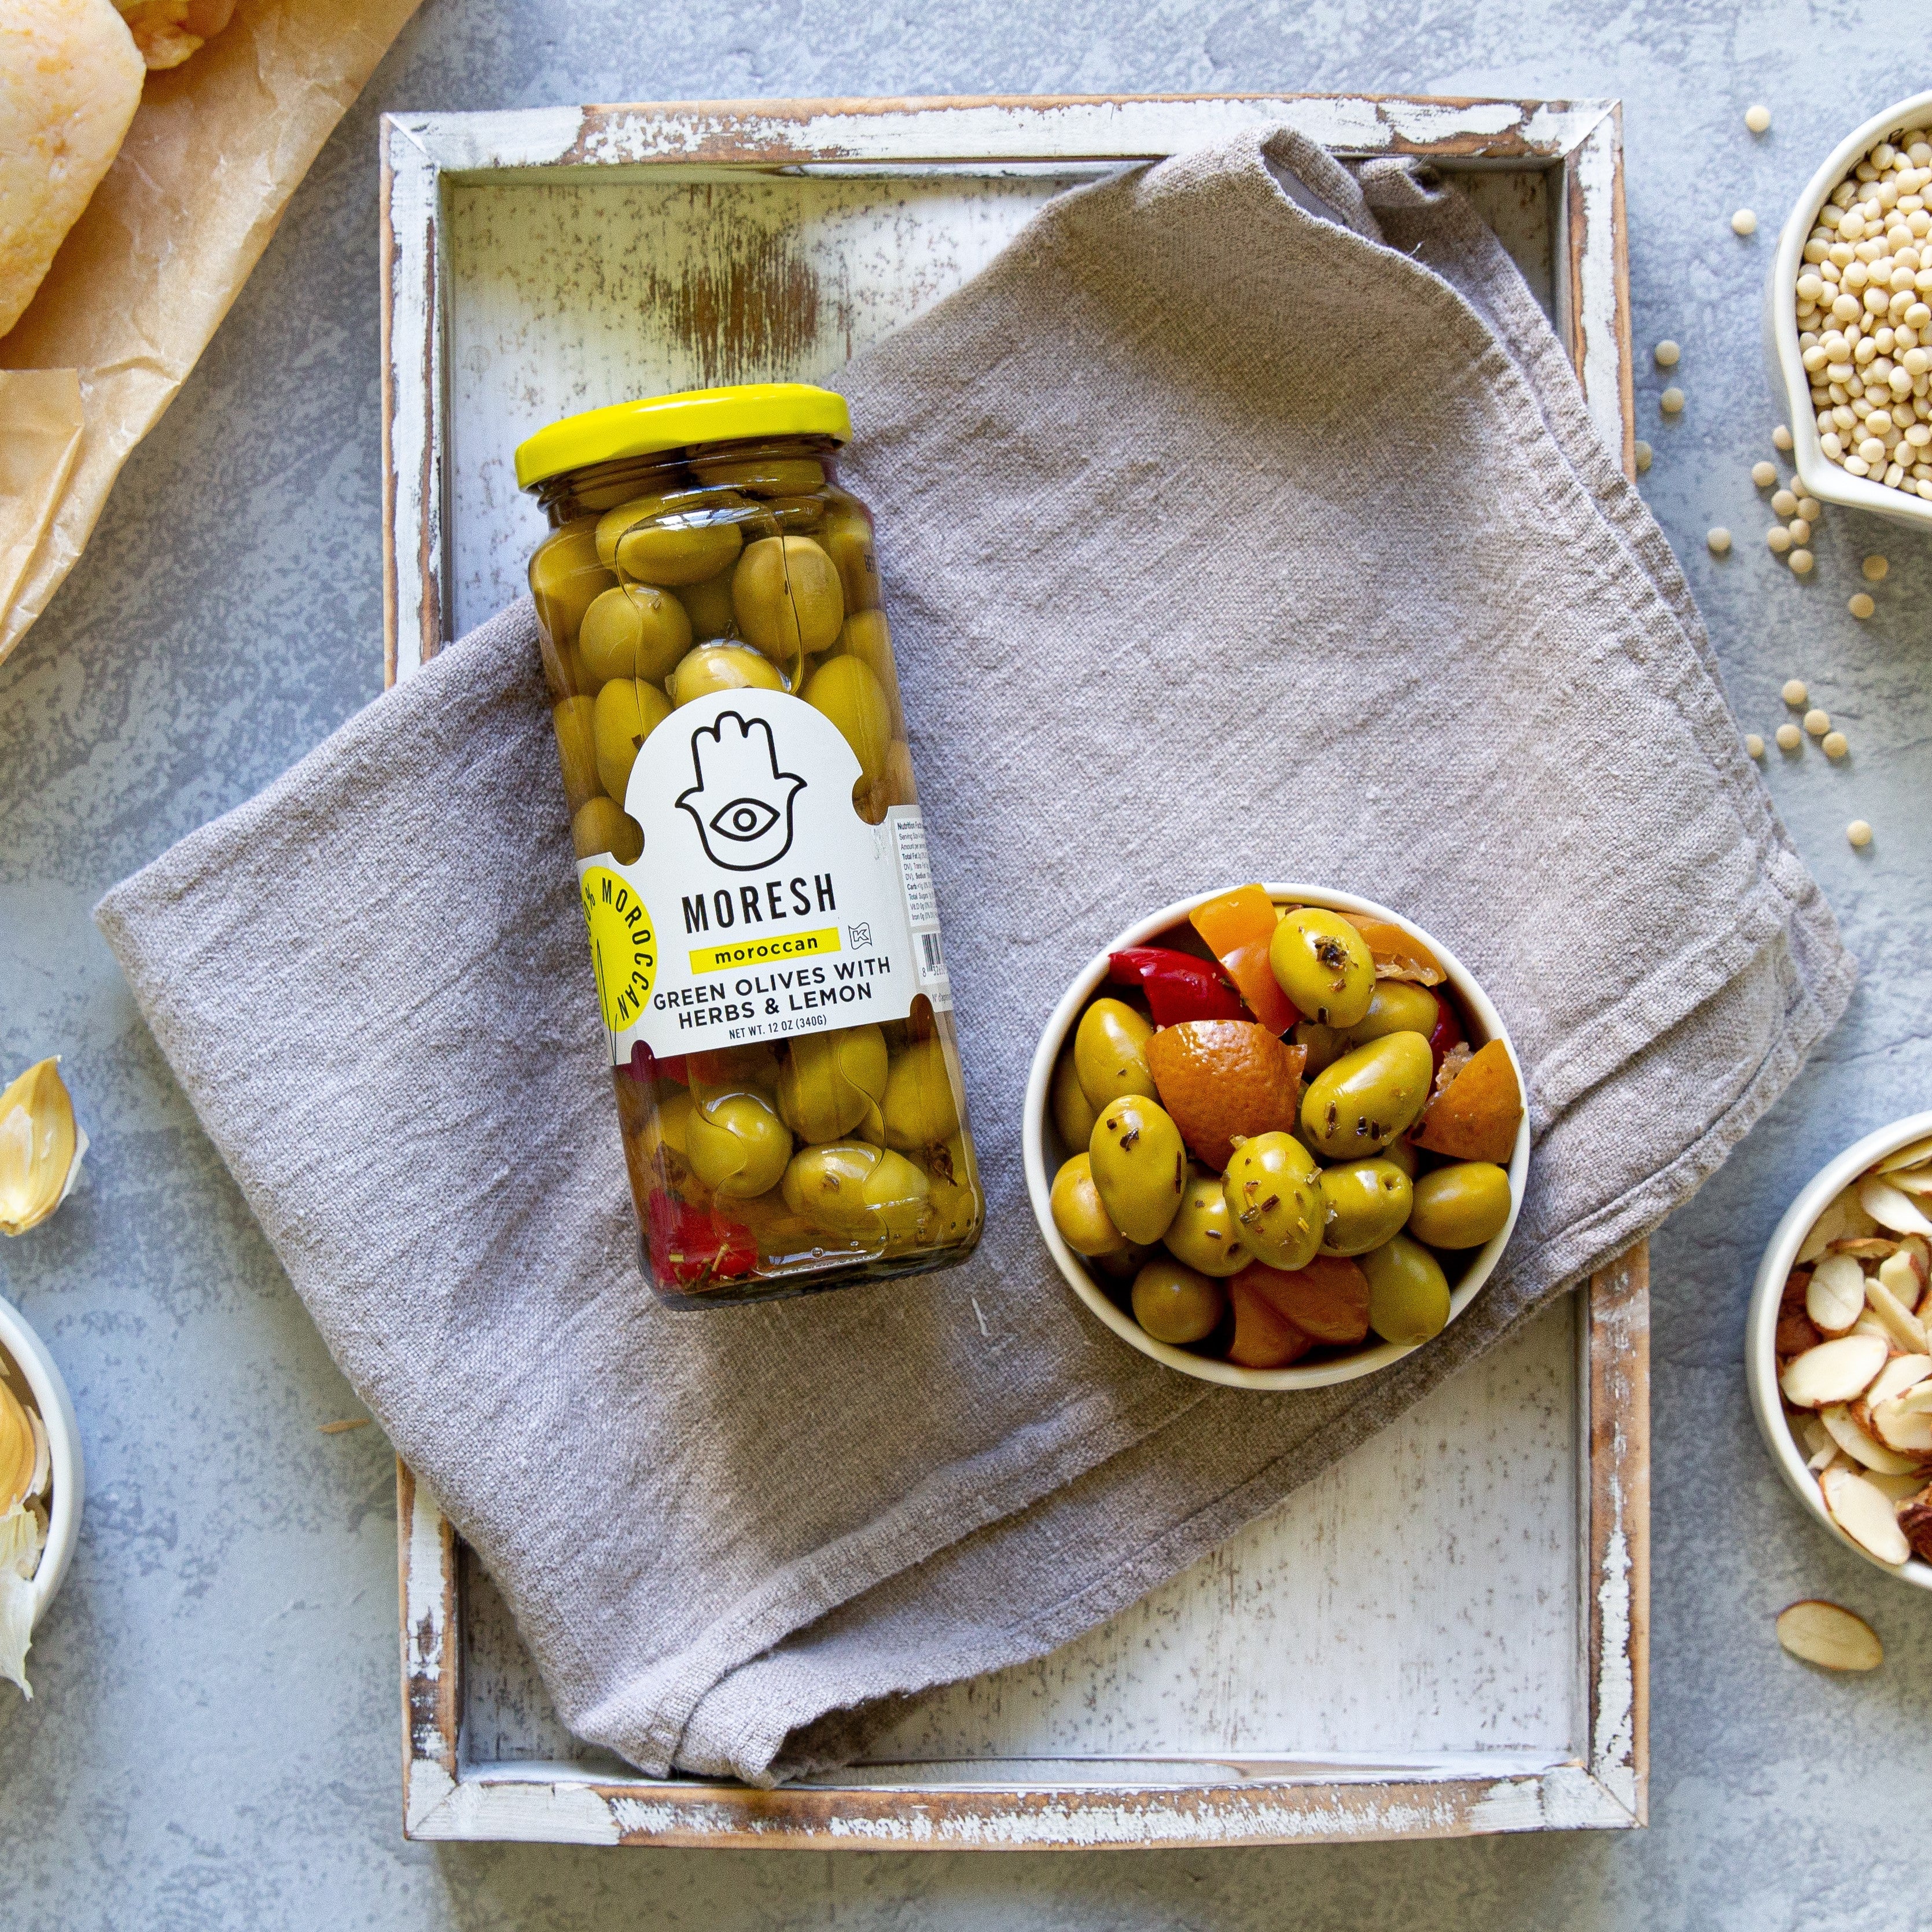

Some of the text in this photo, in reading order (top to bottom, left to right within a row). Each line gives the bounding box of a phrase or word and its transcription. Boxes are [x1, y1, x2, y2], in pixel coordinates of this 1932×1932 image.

[681, 873, 836, 934] MORESH
[602, 877, 653, 1021] MOROCCAN
[715, 937, 818, 964] moroccan
[654, 956, 890, 1010] GREEN OLIVES WITH
[679, 982, 873, 1029] HERBS & LEMON
[729, 1014, 827, 1040] NET WT. 12 OZ (340G)
